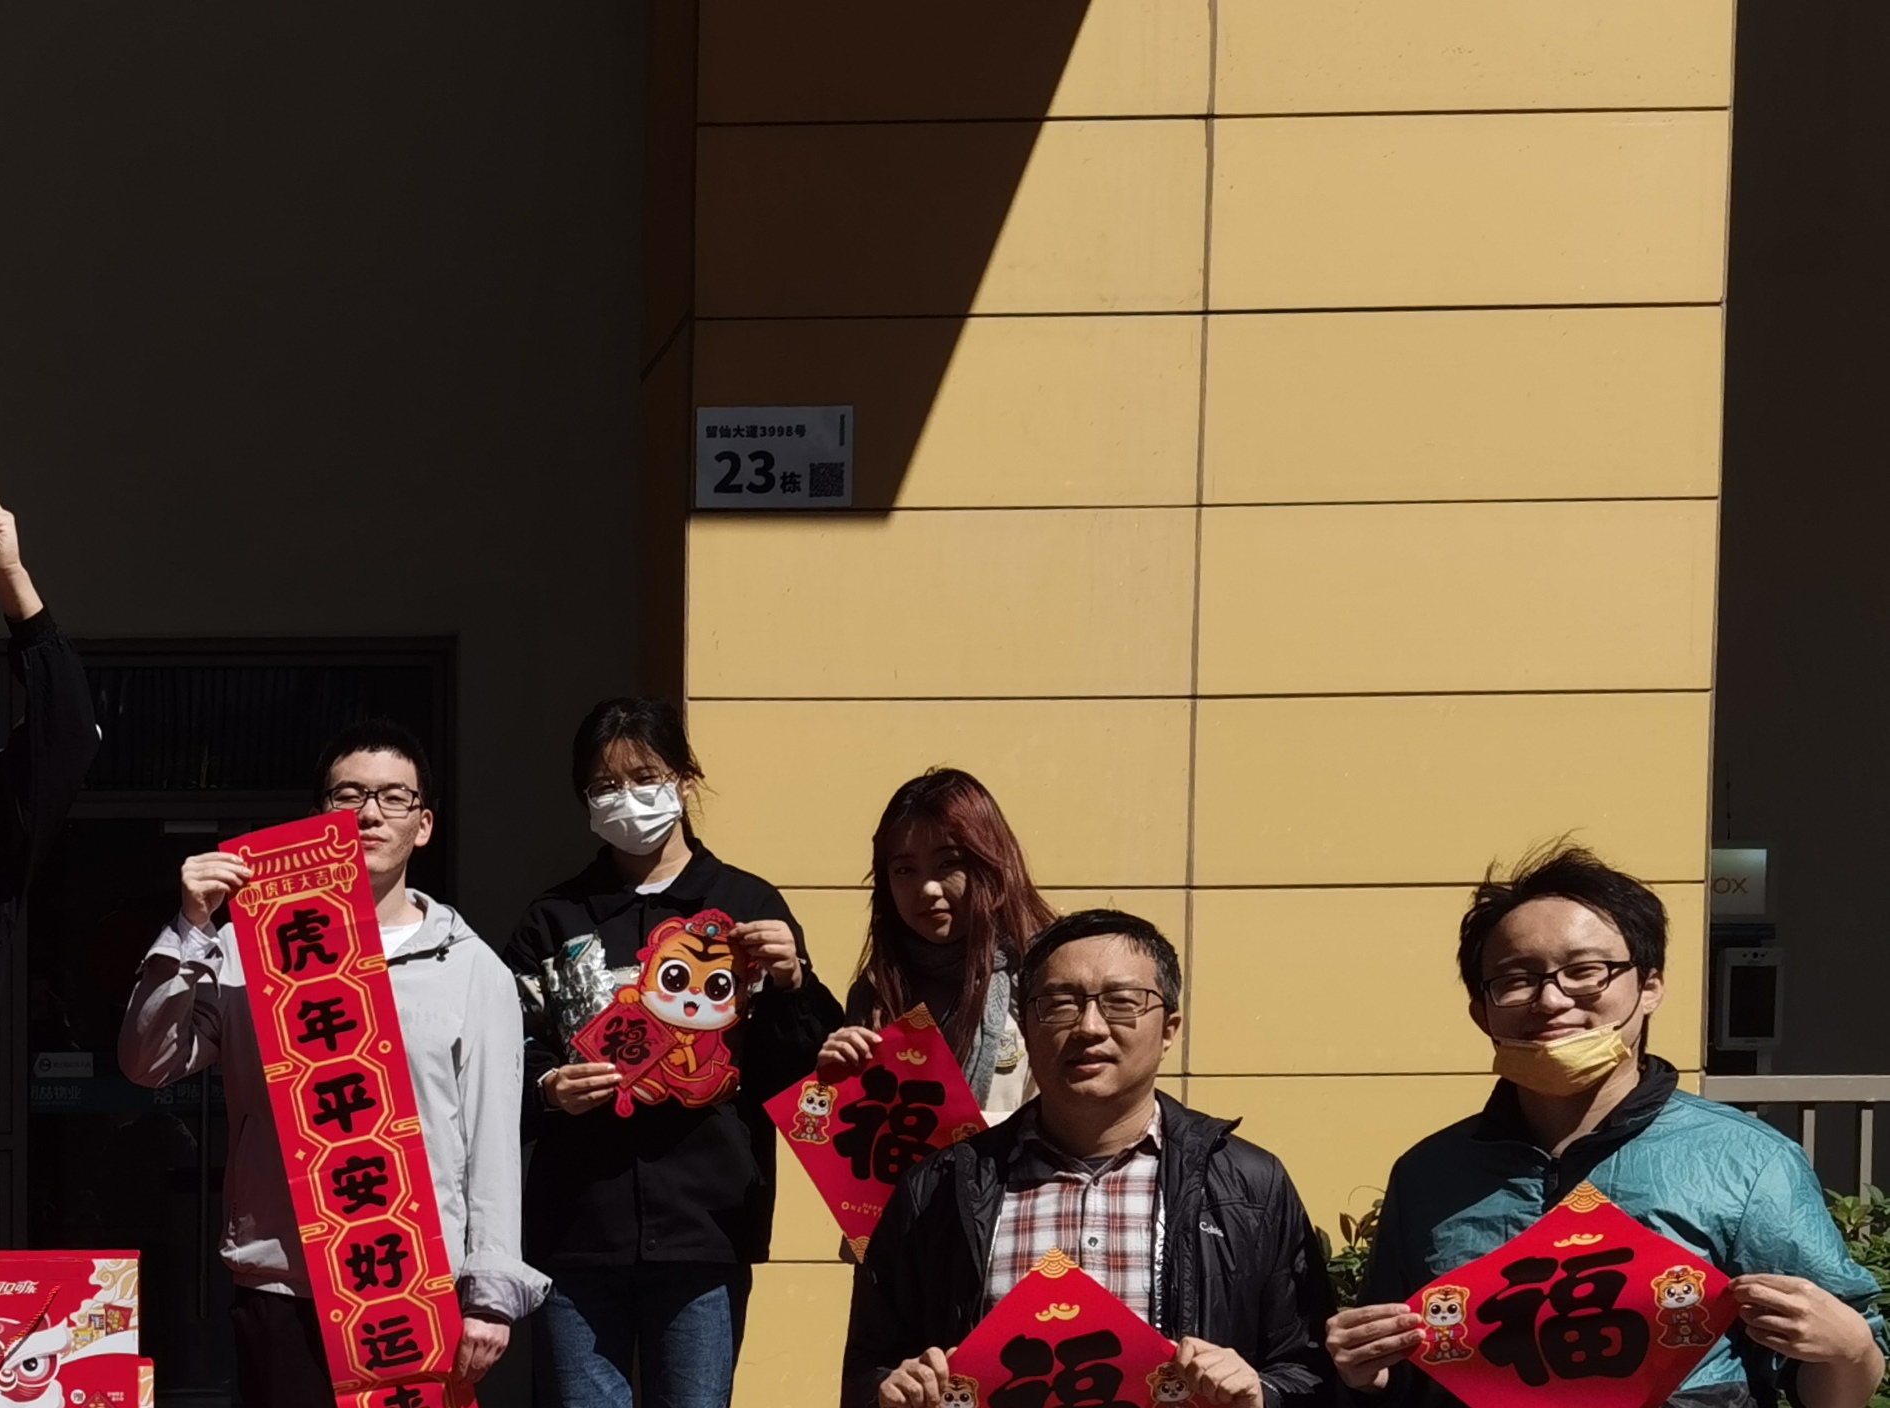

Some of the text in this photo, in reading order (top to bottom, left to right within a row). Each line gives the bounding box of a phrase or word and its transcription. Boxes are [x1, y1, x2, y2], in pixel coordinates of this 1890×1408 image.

[705, 424, 807, 439] 留仙大道3998号
[265, 870, 329, 898] 虎年大吉
[599, 1016, 652, 1066] 福
[833, 1064, 946, 1186] 福
[1475, 1246, 1650, 1388] 福
